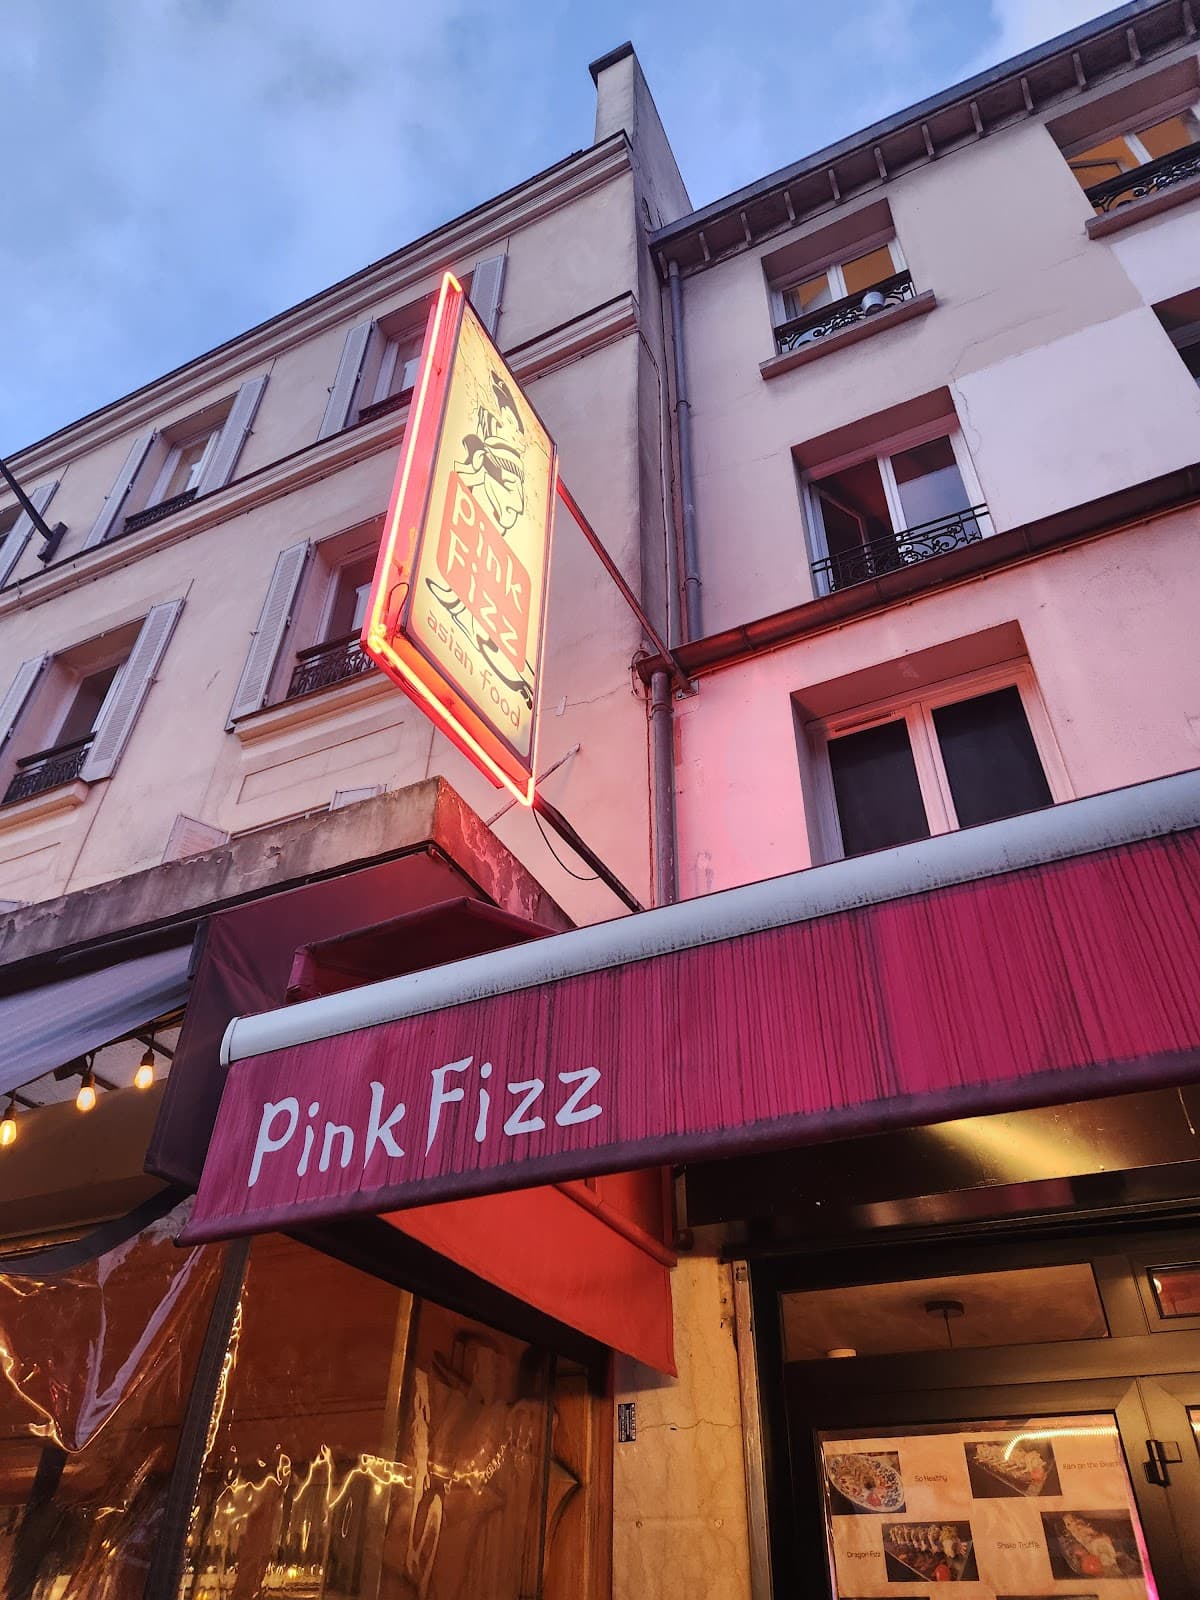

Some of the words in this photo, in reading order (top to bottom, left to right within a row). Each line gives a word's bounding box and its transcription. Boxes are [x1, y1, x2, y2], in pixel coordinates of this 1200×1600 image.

[446, 528, 520, 658] Fizz
[451, 482, 523, 613] Pink
[427, 609, 474, 676] asian
[480, 669, 521, 730] food
[247, 1080, 406, 1188] Pink
[424, 1055, 603, 1158] Fizz
